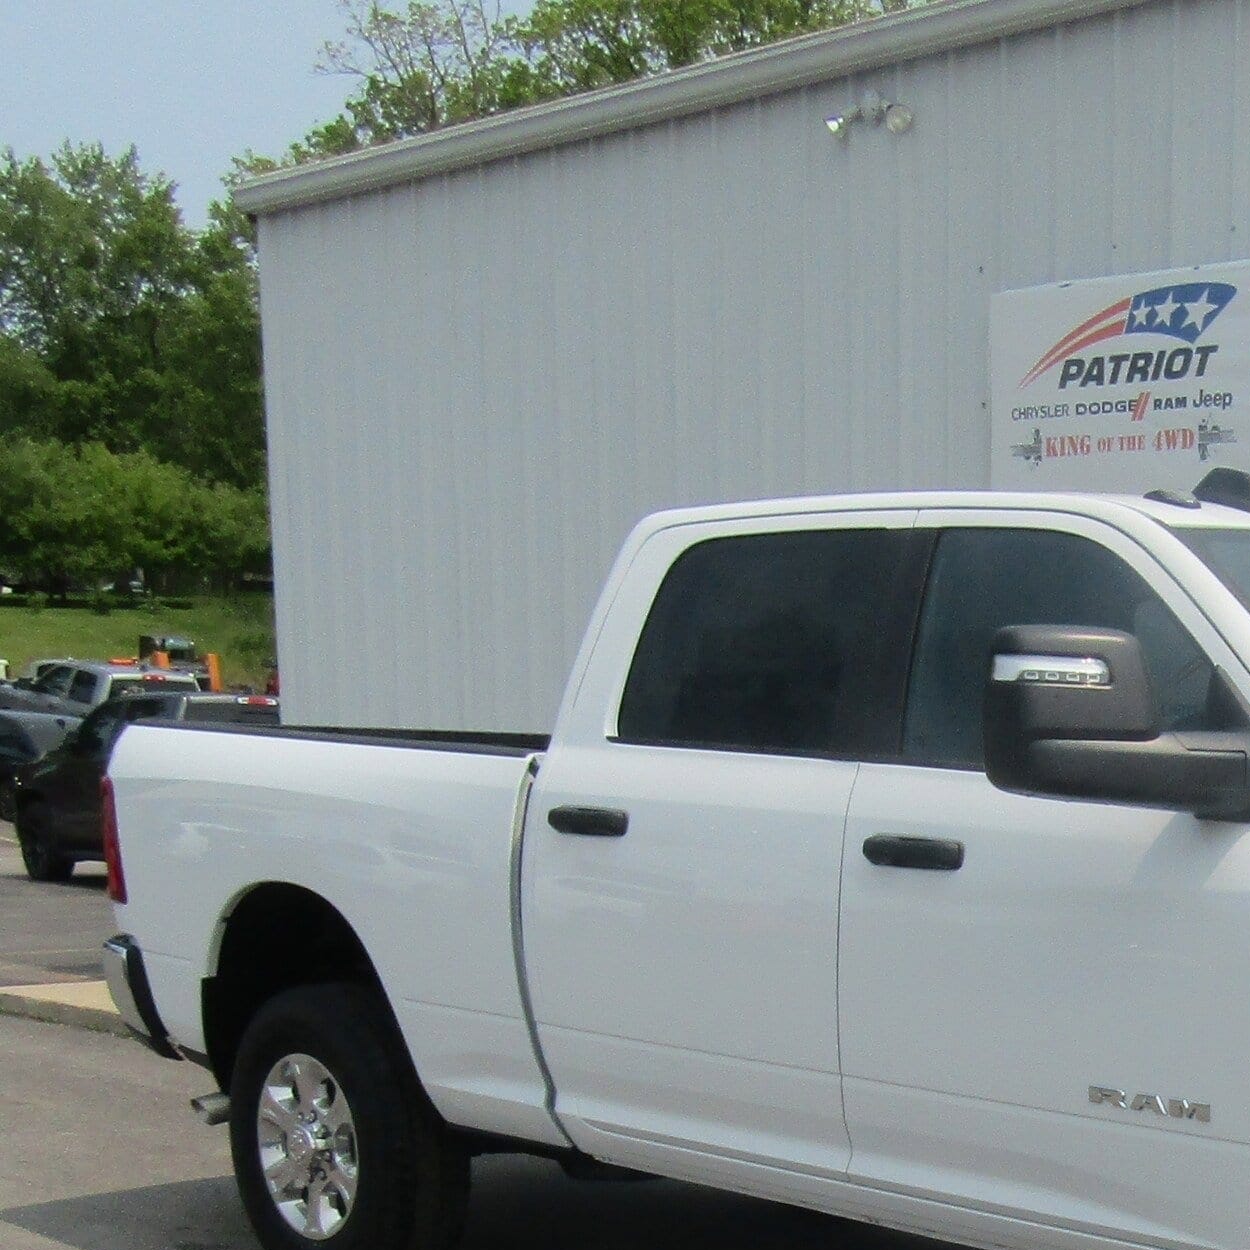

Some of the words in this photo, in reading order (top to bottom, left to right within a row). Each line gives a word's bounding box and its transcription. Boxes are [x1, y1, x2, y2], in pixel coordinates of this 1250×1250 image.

[1058, 345, 1218, 389] PATRIOT
[1012, 403, 1069, 421] CHRYSLER
[1075, 400, 1138, 415] DODGE
[1154, 396, 1187, 410] RAM
[1193, 389, 1232, 409] Jeep
[1045, 435, 1091, 457] KING
[1155, 428, 1195, 451] 4WD
[1088, 1085, 1211, 1122] RAM
